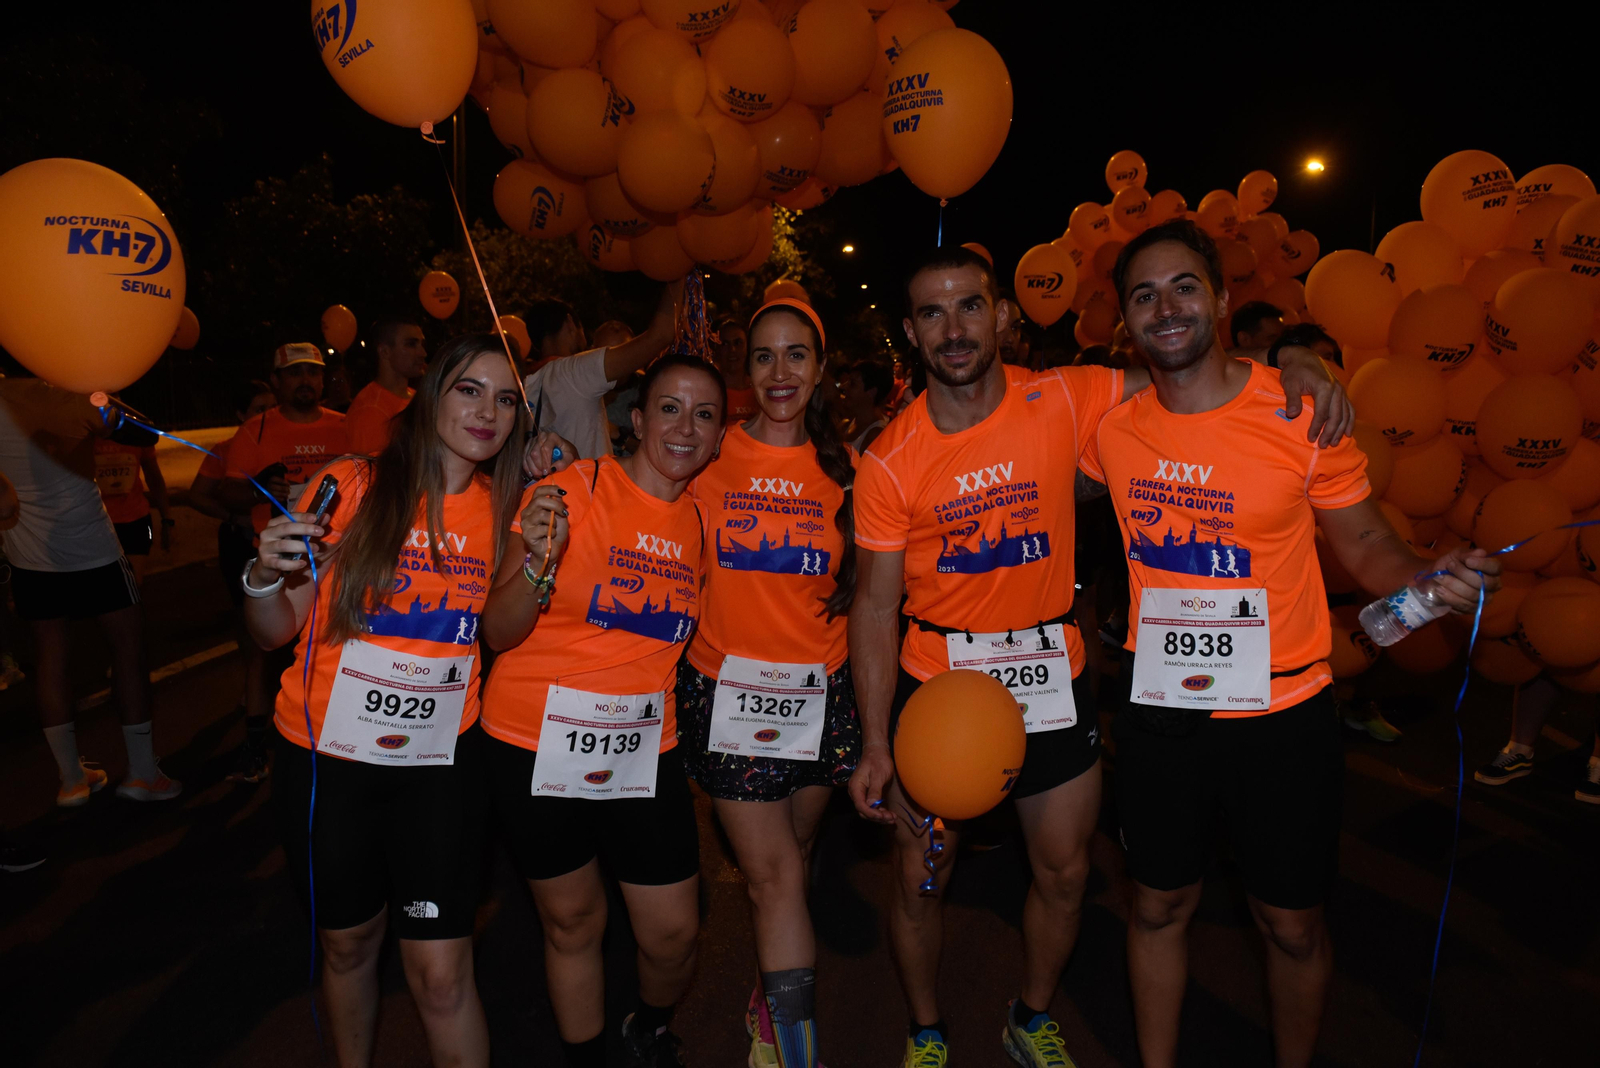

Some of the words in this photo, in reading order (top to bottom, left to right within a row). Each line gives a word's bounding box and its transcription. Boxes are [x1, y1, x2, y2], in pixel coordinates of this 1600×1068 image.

[688, 1, 729, 22] XXXV
[338, 39, 375, 68] SEVILLA
[728, 86, 767, 103] XXXV
[887, 73, 930, 98] XXXV
[901, 89, 943, 101] NOCTURNA
[1470, 170, 1509, 187] XXXV
[44, 216, 131, 230] NOCTURNA
[120, 279, 172, 299] SEVILLA
[295, 445, 326, 454] XXXV
[1503, 446, 1533, 454] CARRERA
[1517, 437, 1562, 450] XXXV
[98, 467, 130, 477] 20872
[954, 461, 1013, 495] XXXV
[1153, 459, 1214, 485] XXXV
[748, 477, 804, 497] XXXV
[934, 494, 983, 514] CARRERA
[986, 480, 1038, 498] NOCTURNA
[1130, 478, 1172, 493] CARRERA
[1177, 485, 1235, 501] NOCTURNA
[724, 492, 769, 502] CARRERA
[772, 496, 823, 508] NOCTURNA
[730, 501, 825, 519] GUADALQUIVIR
[944, 490, 1039, 522] GUADALQUIVIR
[1134, 489, 1235, 514] GUADALQUIVIR
[635, 531, 683, 559] XXXV
[610, 545, 653, 564] CARRERA
[656, 558, 694, 575] NOCTURNA
[616, 557, 695, 587] GUADALQUIVIR
[1164, 632, 1233, 657] 8938
[1164, 660, 1186, 668] RAMÓN
[344, 669, 358, 677] XXXV
[358, 673, 379, 683] CARRERA
[379, 679, 405, 689] NOCTURNA
[980, 664, 1049, 688] 3269
[1034, 688, 1059, 696] VALENTÍN
[1228, 696, 1263, 704] Cruzcampo
[365, 690, 436, 720] 9929
[736, 692, 807, 717] 13267
[358, 715, 373, 724] ALBA
[374, 719, 407, 730] SANTAELLA
[1041, 716, 1072, 725] Cruzcampo
[566, 731, 641, 755] 19139
